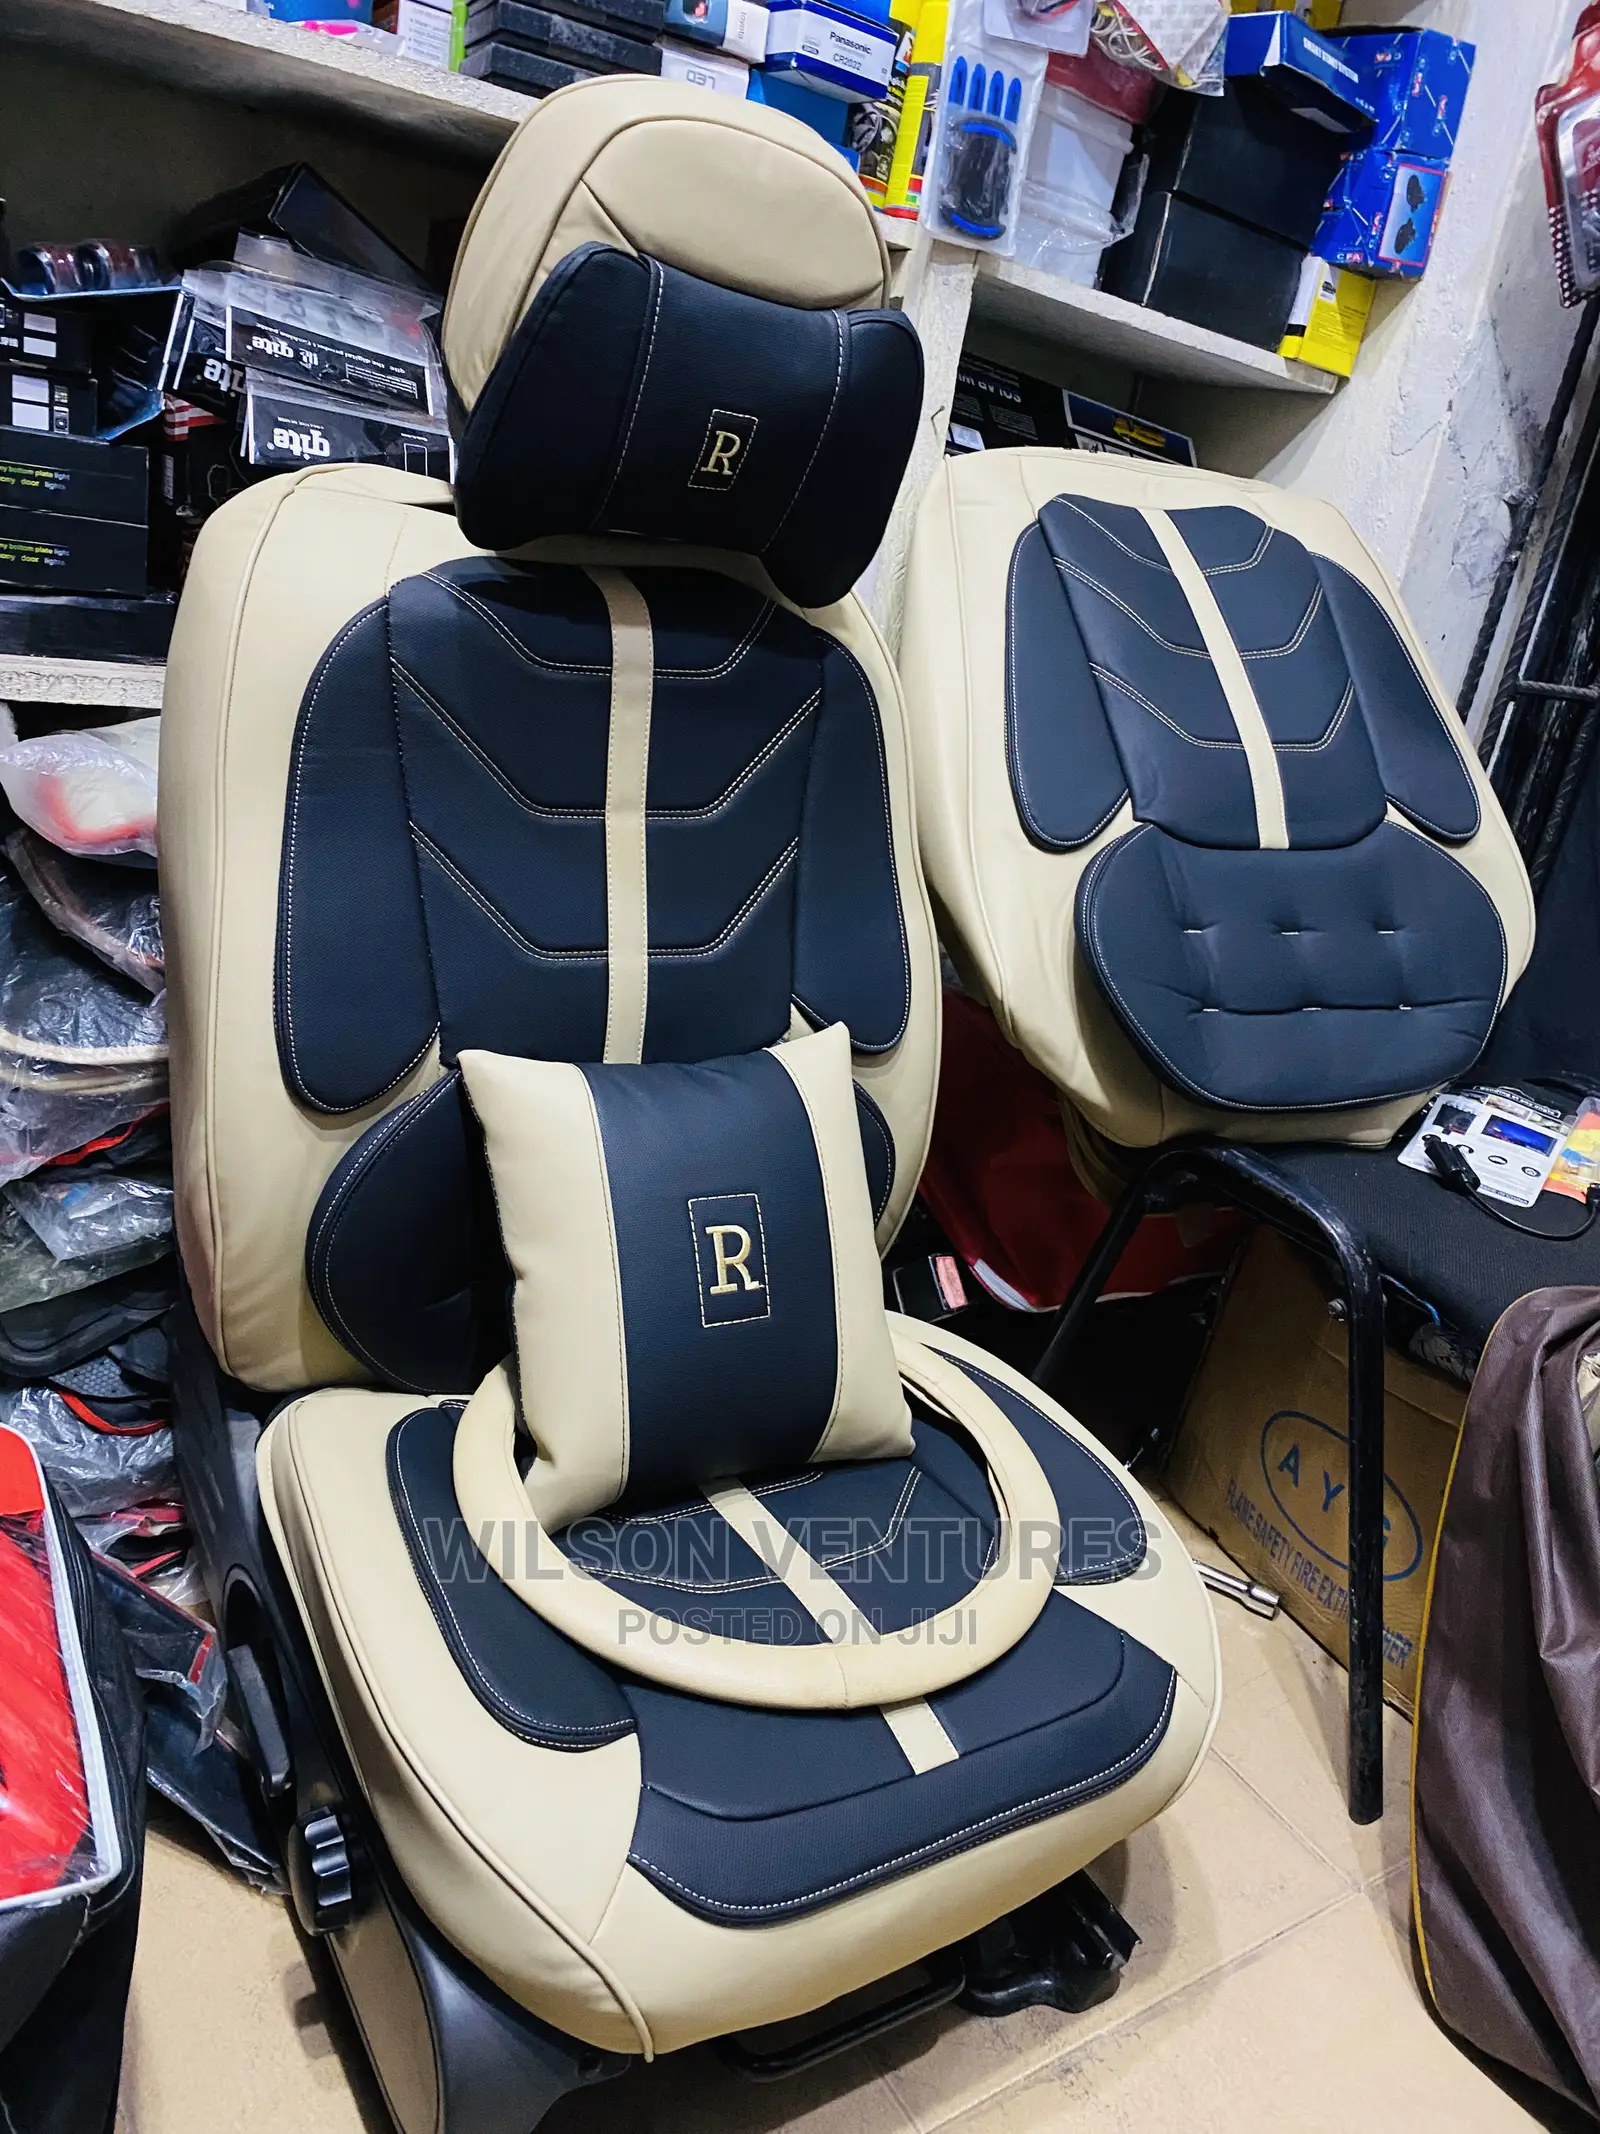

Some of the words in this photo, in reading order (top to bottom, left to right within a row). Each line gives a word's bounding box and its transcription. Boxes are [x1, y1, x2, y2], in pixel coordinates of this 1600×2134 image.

[830, 31, 872, 54] Panasonic
[833, 53, 862, 71] CR2032
[687, 69, 716, 90] LED
[251, 334, 295, 359] qite
[273, 427, 331, 461] qite
[701, 430, 741, 476] R
[705, 1224, 760, 1295] R
[1253, 1512, 1294, 1567] SAFETY
[1290, 1551, 1321, 1594] FIRE
